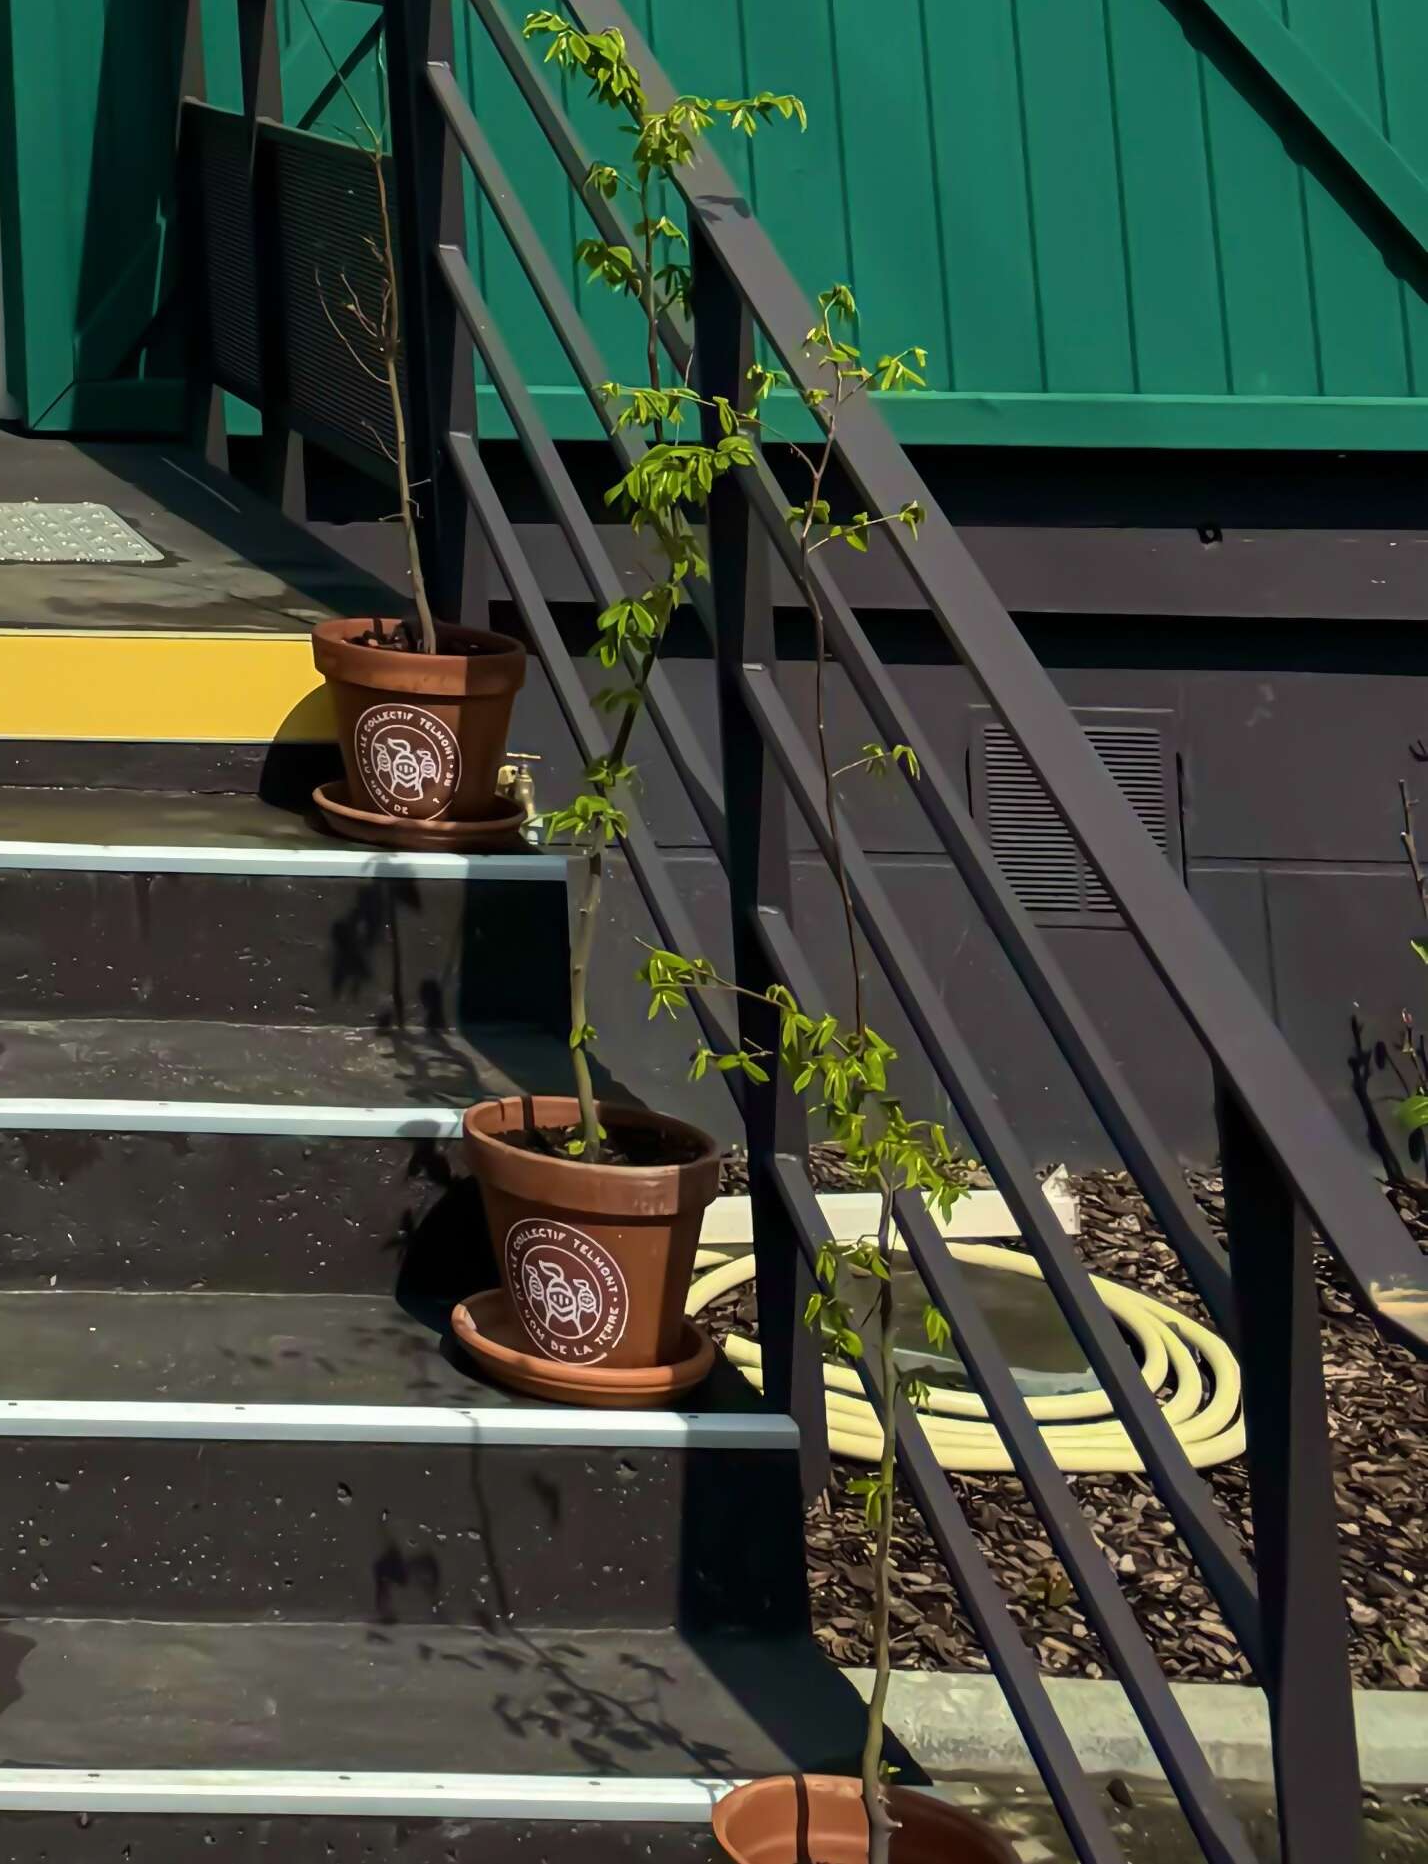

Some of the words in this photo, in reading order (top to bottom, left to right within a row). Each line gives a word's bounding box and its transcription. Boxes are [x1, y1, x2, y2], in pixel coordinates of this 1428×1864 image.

[363, 710, 414, 732] COLLECTIF
[419, 717, 455, 760] TELMONT
[513, 1228, 567, 1251] COLLECTIF
[572, 1238, 618, 1293] TELMONT
[550, 1340, 567, 1355] DE
[573, 1344, 593, 1356] LA
[594, 1306, 619, 1345] TERRE
